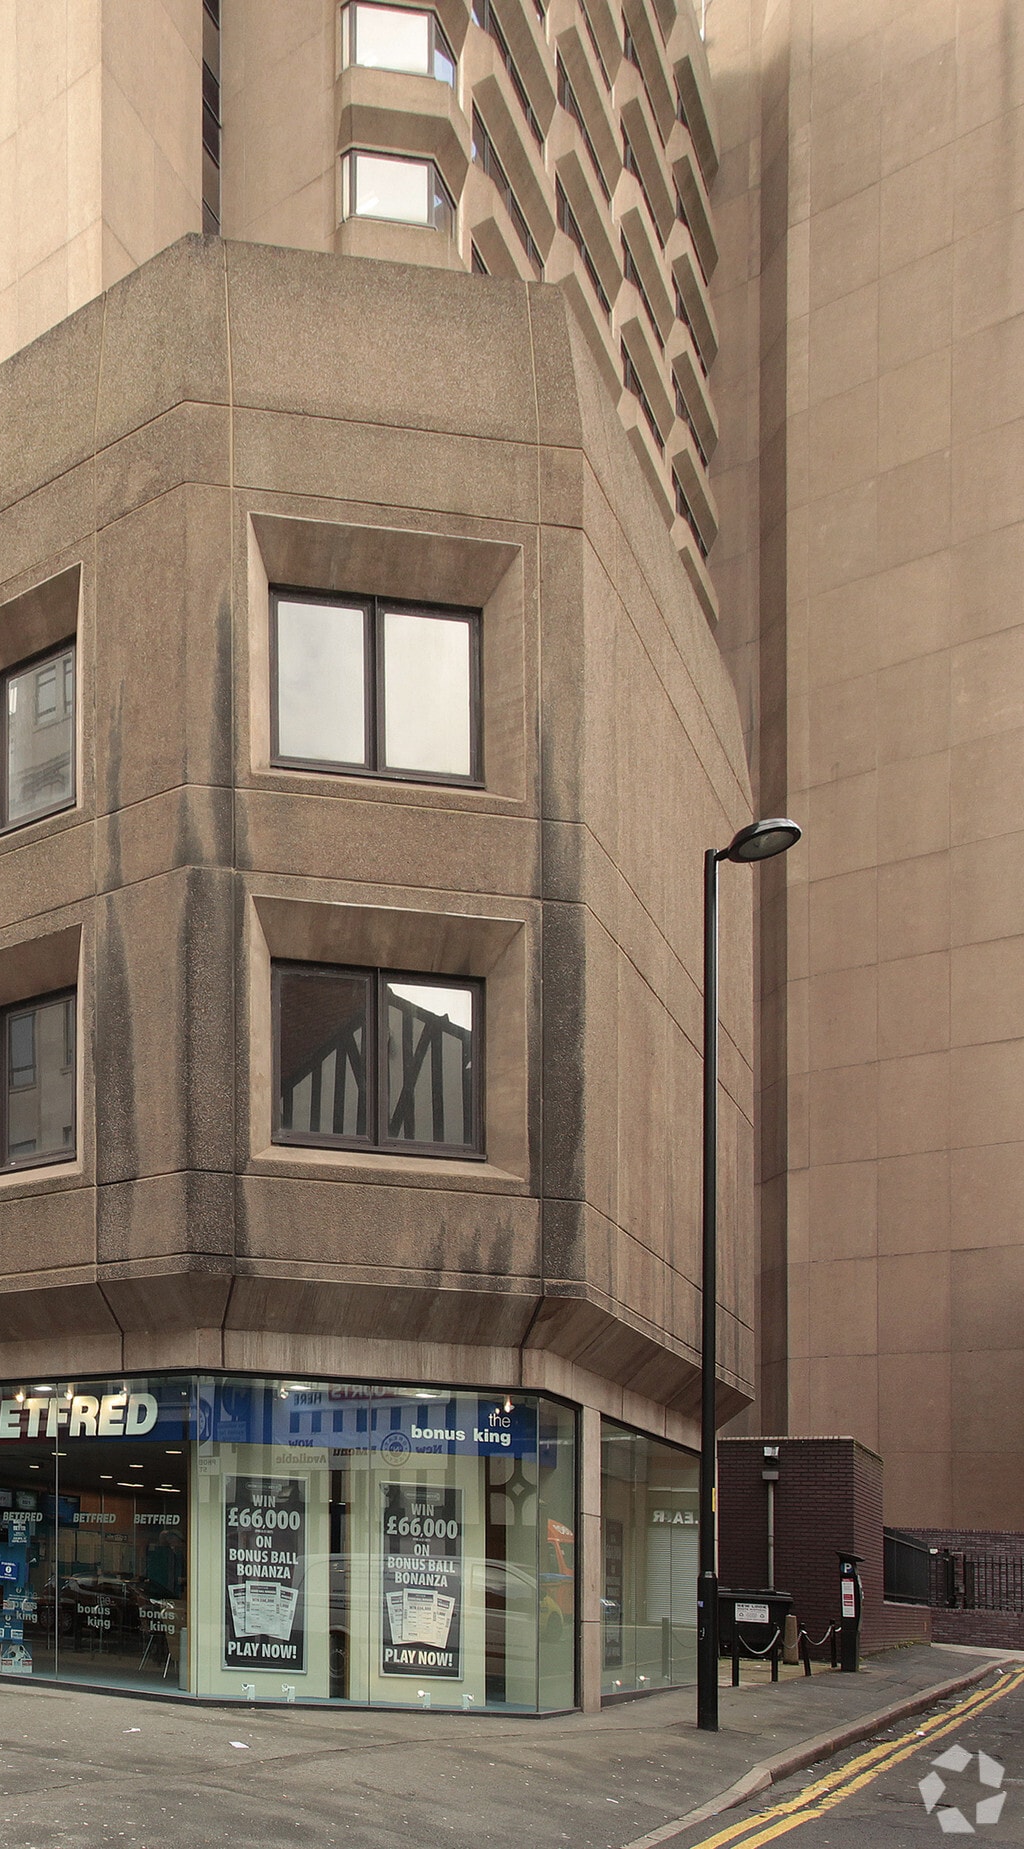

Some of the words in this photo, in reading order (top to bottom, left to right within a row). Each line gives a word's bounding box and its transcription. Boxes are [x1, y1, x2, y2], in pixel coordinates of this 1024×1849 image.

[488, 1411, 511, 1428] the
[411, 1424, 466, 1441] bonus
[473, 1425, 511, 1446] king
[252, 1494, 276, 1508] WIN
[2, 1511, 43, 1522] BETFRED
[411, 1503, 434, 1516] WIN
[73, 1513, 116, 1523] BETFRED
[133, 1514, 181, 1525] BETFRED
[228, 1507, 301, 1530] £66,000
[386, 1515, 458, 1539] £66,000
[256, 1536, 272, 1548] ON
[229, 1549, 268, 1563] BONUS
[271, 1551, 299, 1565] BALL
[414, 1544, 430, 1556] ON
[236, 1564, 291, 1579] BONANZA
[388, 1556, 426, 1571] BONUS
[428, 1559, 456, 1573] BALL
[395, 1571, 448, 1587] BONANZA
[77, 1603, 111, 1615] bonus
[139, 1607, 175, 1620] bonus
[16, 1610, 38, 1623] king
[87, 1616, 111, 1629] king
[149, 1621, 175, 1635] king
[227, 1641, 260, 1658] PLAY
[261, 1643, 297, 1660] NOW!
[385, 1648, 417, 1664] PLAY
[418, 1650, 453, 1667] NOW!
